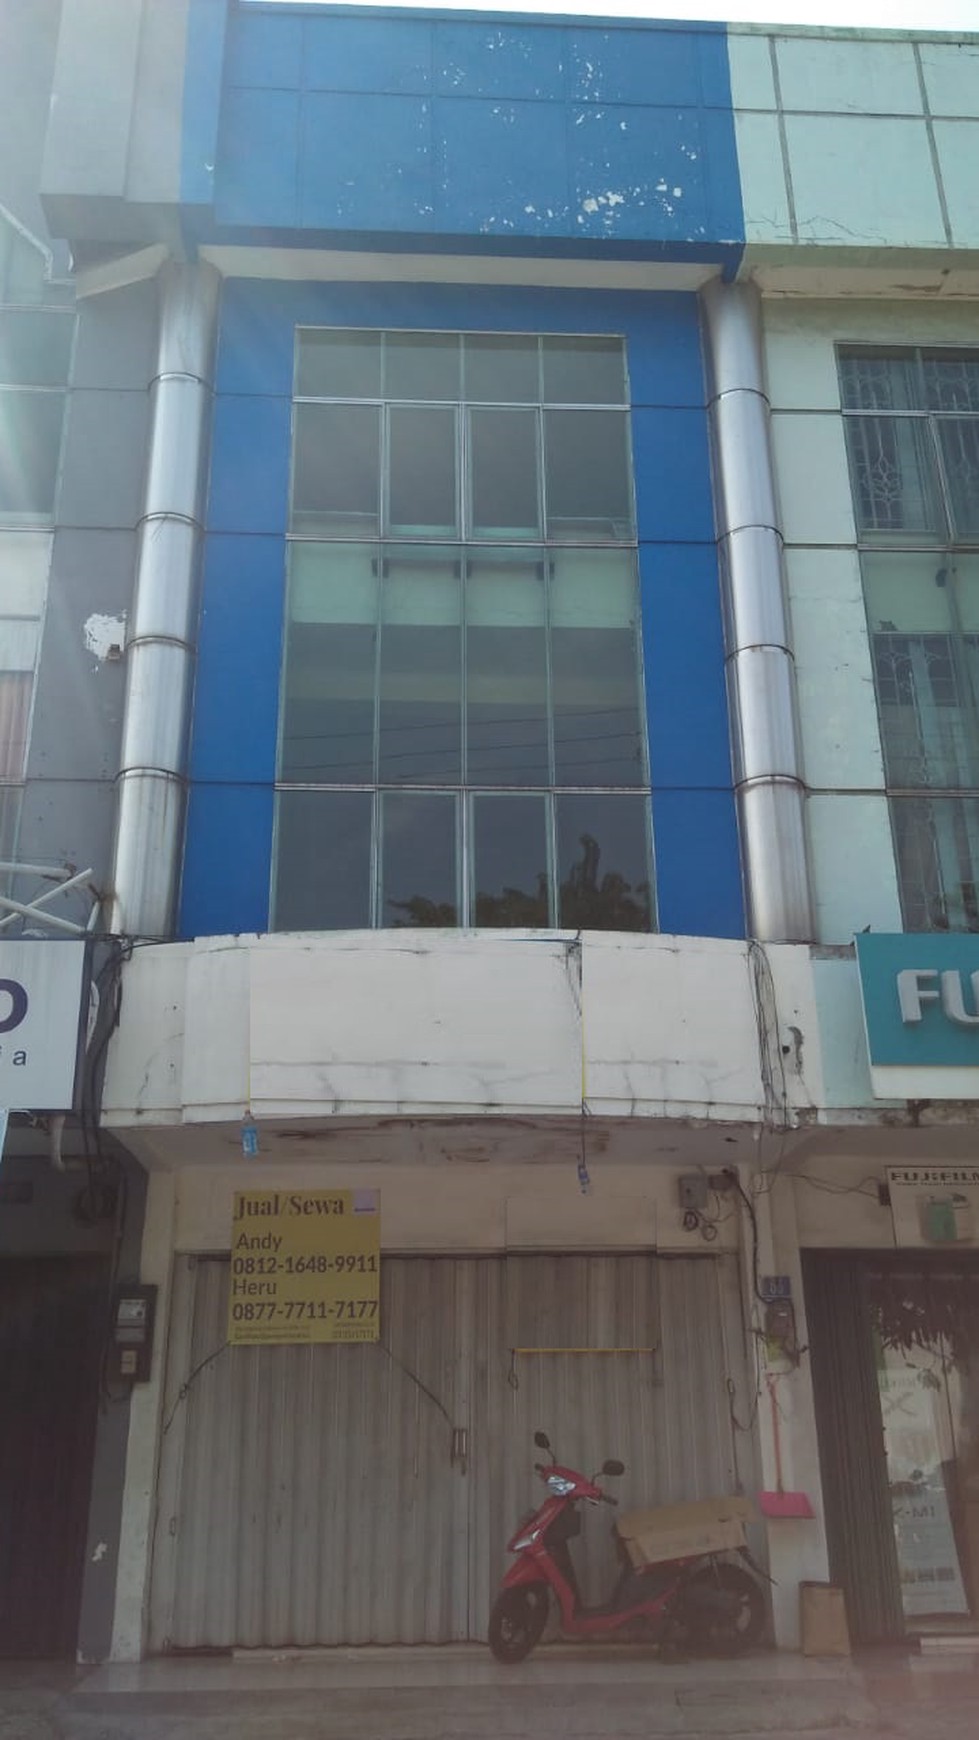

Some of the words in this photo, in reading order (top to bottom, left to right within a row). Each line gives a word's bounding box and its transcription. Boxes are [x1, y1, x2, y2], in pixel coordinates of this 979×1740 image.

[233, 1194, 344, 1221] Jual/Sewa
[236, 1232, 283, 1253] Andy
[233, 1254, 378, 1275] 0812-1648-9911
[232, 1278, 277, 1296] Heru
[232, 1301, 378, 1321] 0877-7711-7177
